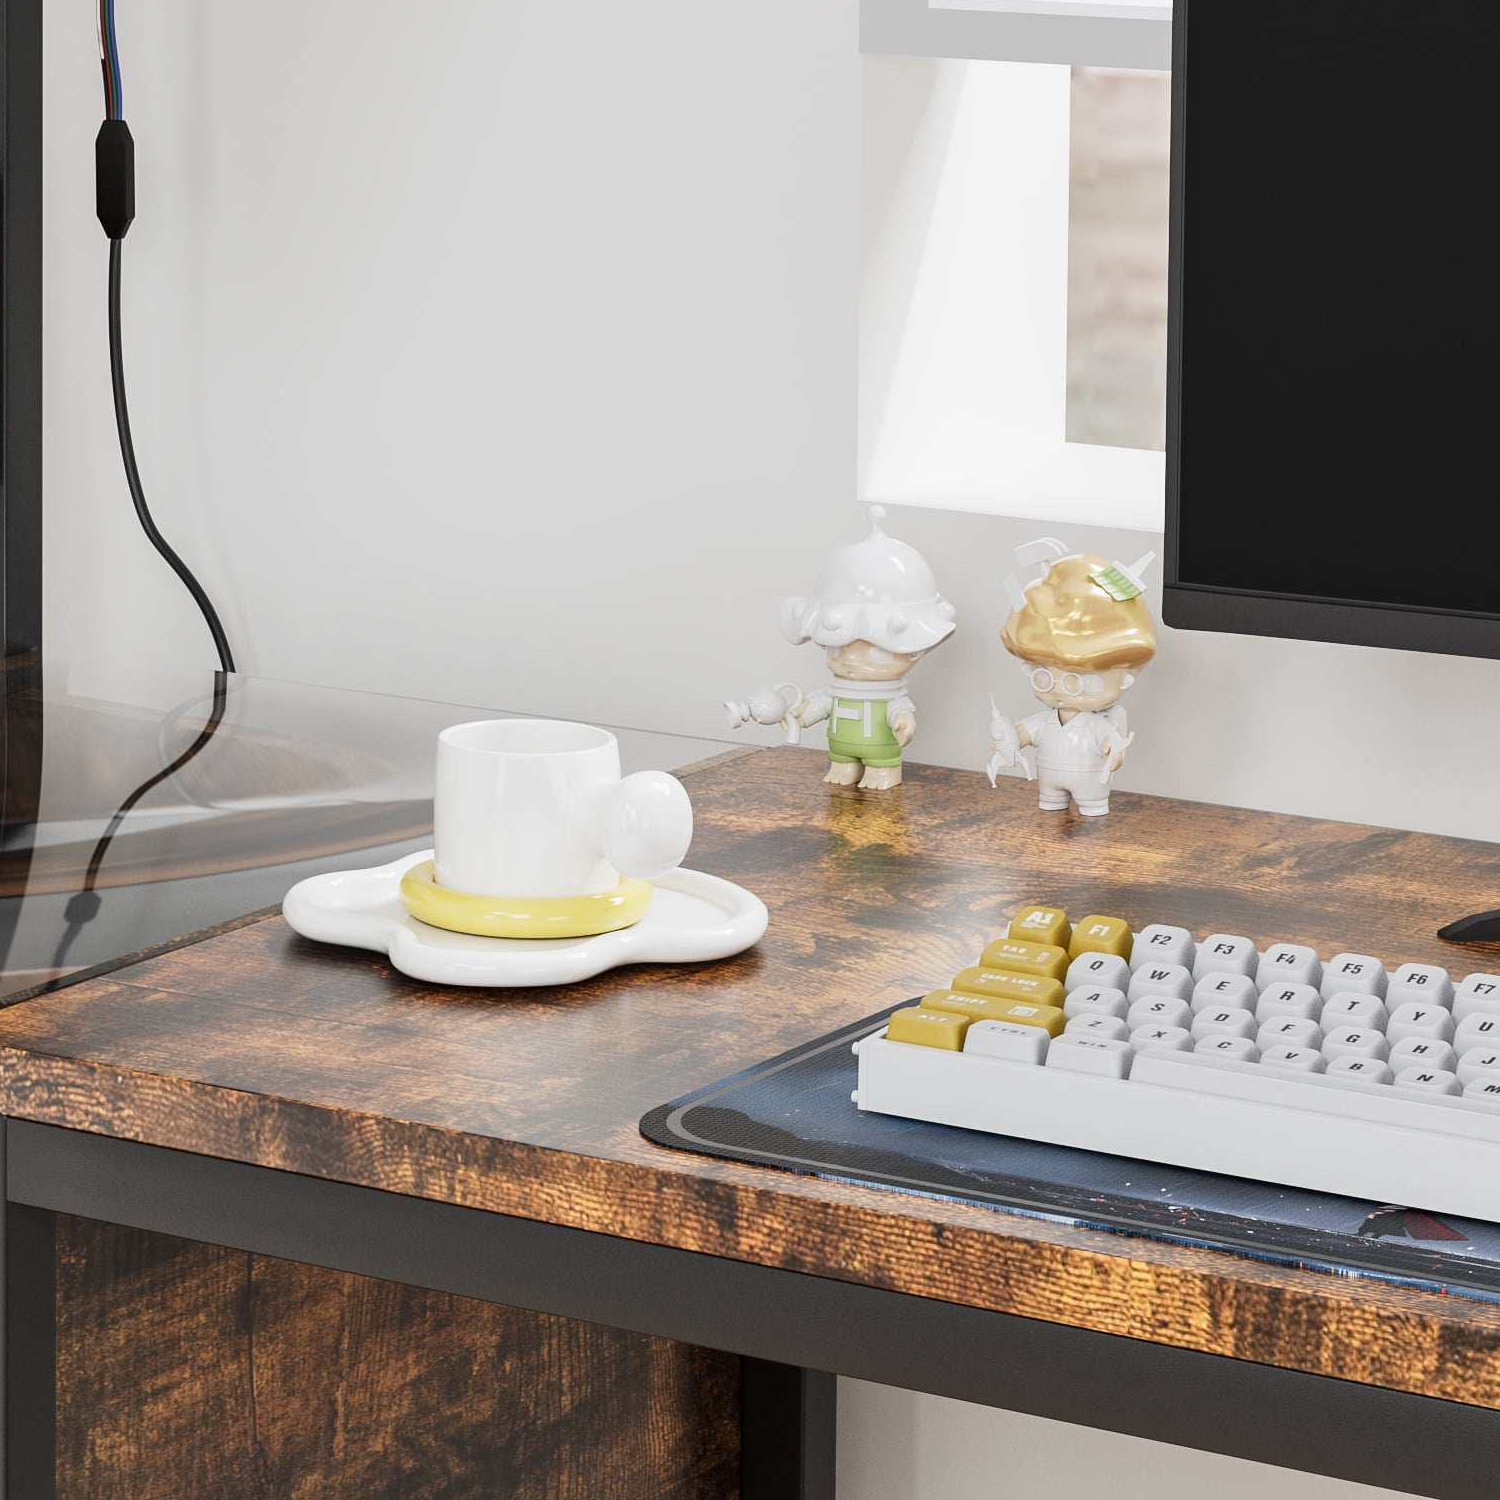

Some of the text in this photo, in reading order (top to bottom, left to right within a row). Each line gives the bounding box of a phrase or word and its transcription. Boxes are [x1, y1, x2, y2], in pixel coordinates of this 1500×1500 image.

[1088, 924, 1111, 937] F1
[1150, 934, 1172, 946] F2
[1001, 944, 1027, 954] TAB
[1213, 943, 1235, 955] F3
[1275, 953, 1296, 965] F4
[1089, 960, 1104, 971] Q
[1341, 963, 1364, 975] F5
[980, 973, 1040, 987] CAPS LOCK
[1150, 970, 1170, 981] W
[1406, 973, 1429, 985] F6
[1215, 981, 1231, 991] E
[1473, 983, 1496, 995] F7
[946, 994, 988, 1005] SHIFT
[1086, 993, 1101, 1002] A
[1279, 991, 1296, 1001] R
[1150, 1003, 1165, 1012] S
[1347, 1001, 1360, 1011] T
[1214, 1013, 1230, 1022] D
[1413, 1011, 1427, 1021] Y
[1087, 1020, 1102, 1028] Z
[1280, 1024, 1296, 1032] F
[1479, 1022, 1495, 1032] U
[1151, 1030, 1168, 1039] X
[1345, 1034, 1361, 1043] G
[1216, 1041, 1232, 1049] C
[1412, 1045, 1429, 1054] H
[1284, 1052, 1300, 1060] V
[1481, 1056, 1497, 1065] J
[1348, 1063, 1364, 1071] B
[1416, 1074, 1434, 1082] N
[1484, 1084, 1500, 1094] M
